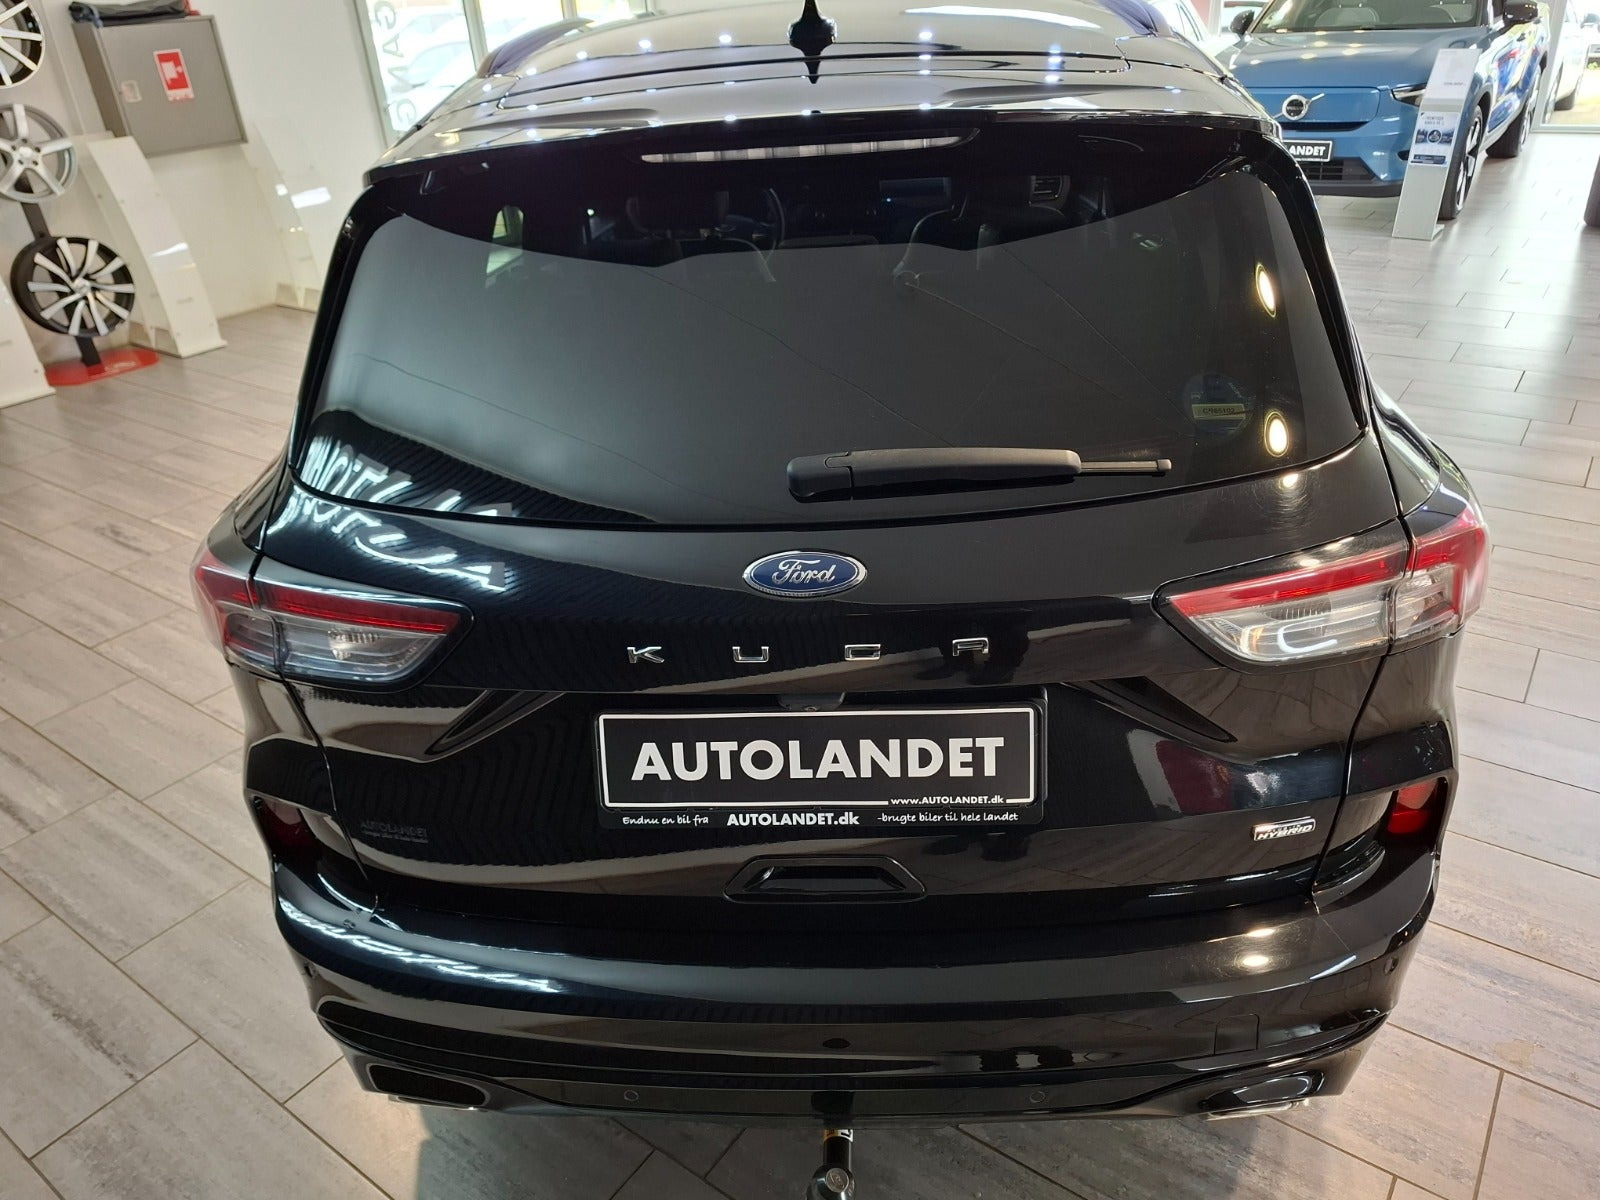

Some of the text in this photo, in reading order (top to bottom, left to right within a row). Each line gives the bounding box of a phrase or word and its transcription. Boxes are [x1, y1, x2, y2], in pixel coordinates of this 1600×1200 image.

[771, 559, 837, 585] Ford
[631, 737, 1005, 781] AUTOLANDET
[890, 794, 1004, 805] www.AUTOLANDET.dk
[622, 814, 709, 826] Endnu en bil fra
[727, 812, 859, 826] AUTOLANDET.dk
[918, 811, 944, 822] biler
[944, 811, 959, 822] til
[960, 811, 981, 822] hele
[983, 811, 1019, 821] landet
